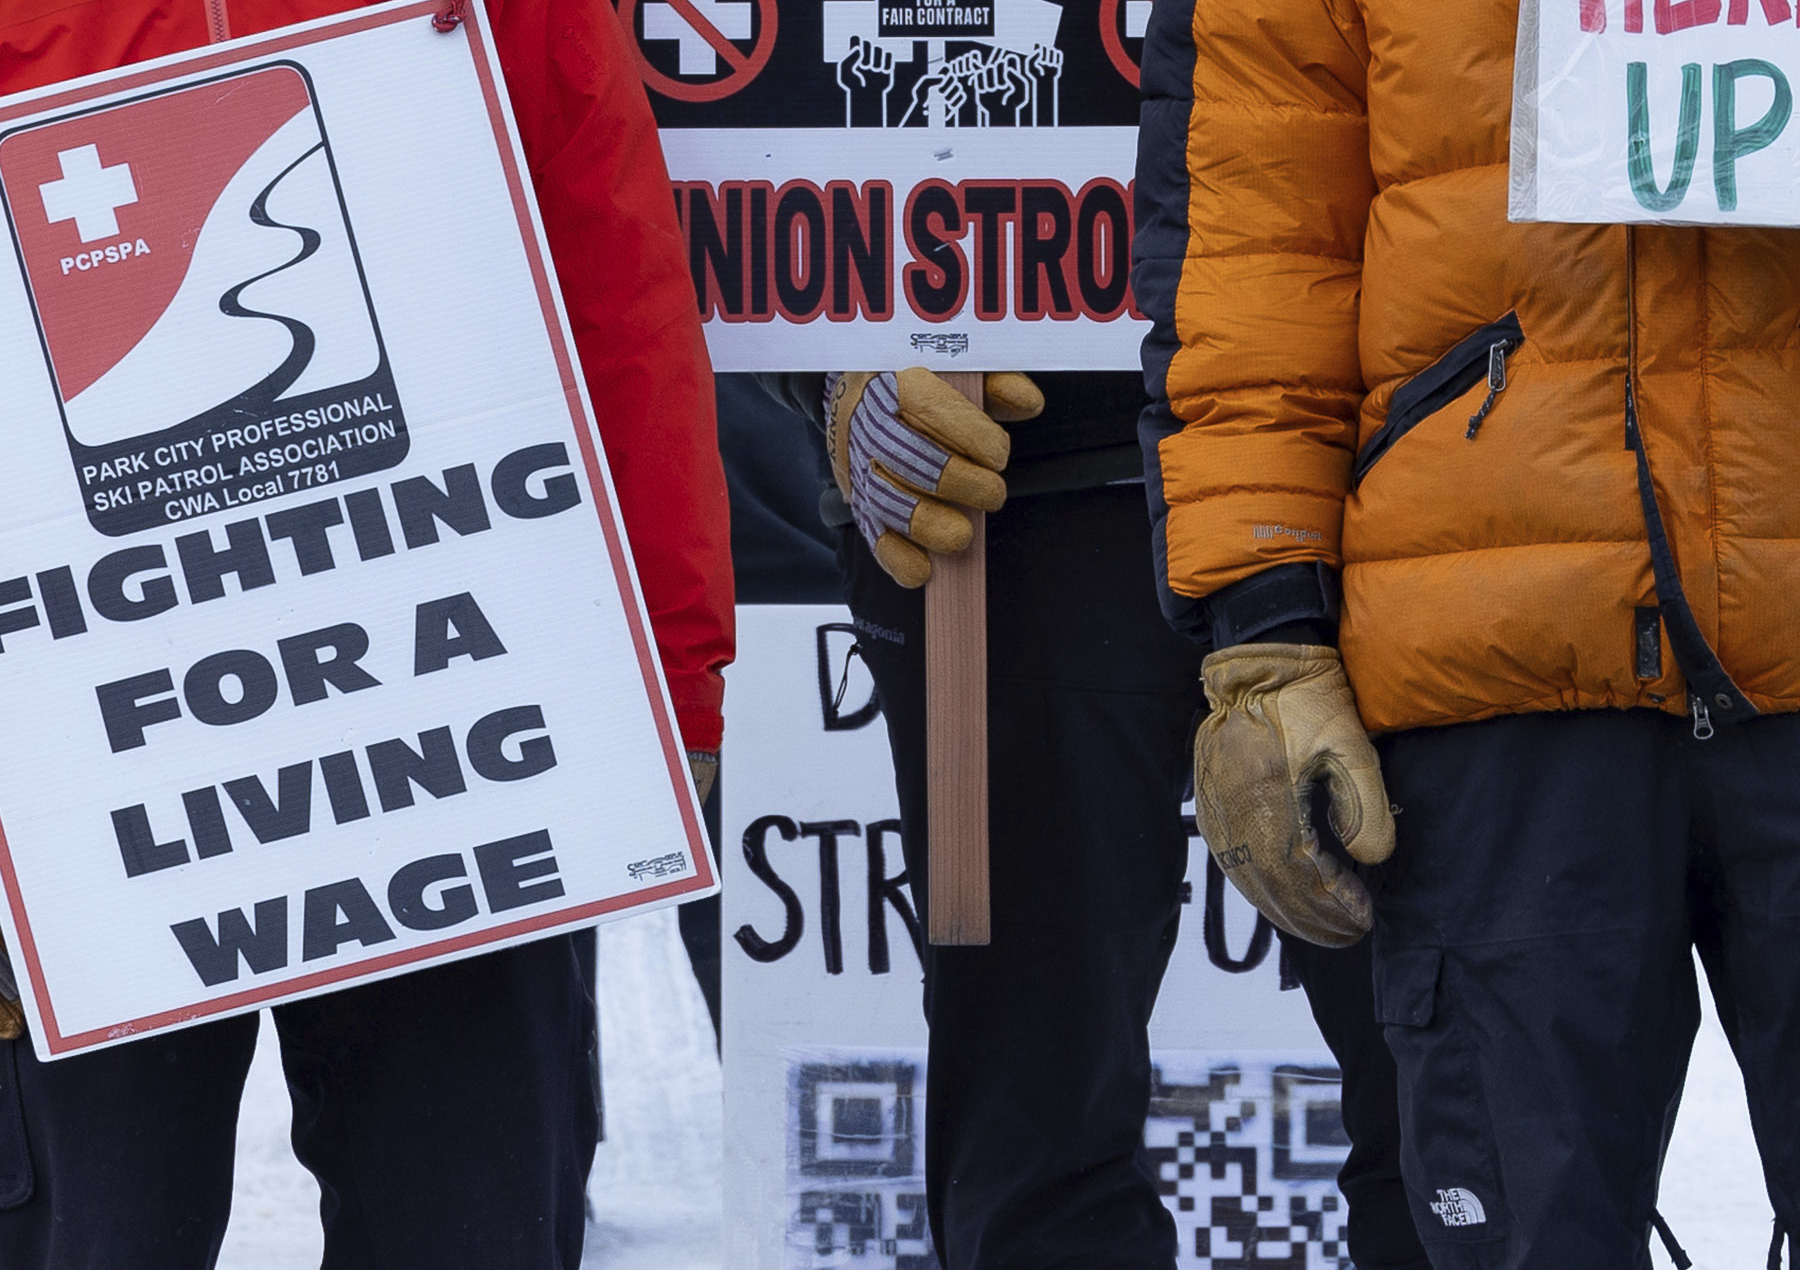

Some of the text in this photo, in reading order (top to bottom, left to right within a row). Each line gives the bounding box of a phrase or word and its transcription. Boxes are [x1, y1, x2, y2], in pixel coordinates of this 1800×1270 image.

[882, 7, 990, 25] FAIR CONTRACT
[1626, 58, 1793, 214] UP
[59, 238, 151, 276] PCPSPA
[670, 180, 895, 323] NION
[82, 392, 393, 484] PARK CITY PROFESSIONAL
[93, 420, 396, 512] SKI PATROL ASSOCIATION
[165, 460, 340, 521] CWA Local 7781
[95, 591, 507, 753] FOR A
[110, 705, 557, 878] LIVING
[1217, 845, 1251, 870] KINCO
[170, 829, 566, 987] WAGE
[1429, 1200, 1463, 1214] NORTH
[1436, 1188, 1460, 1201] THE
[1440, 1212, 1467, 1226] FACE
